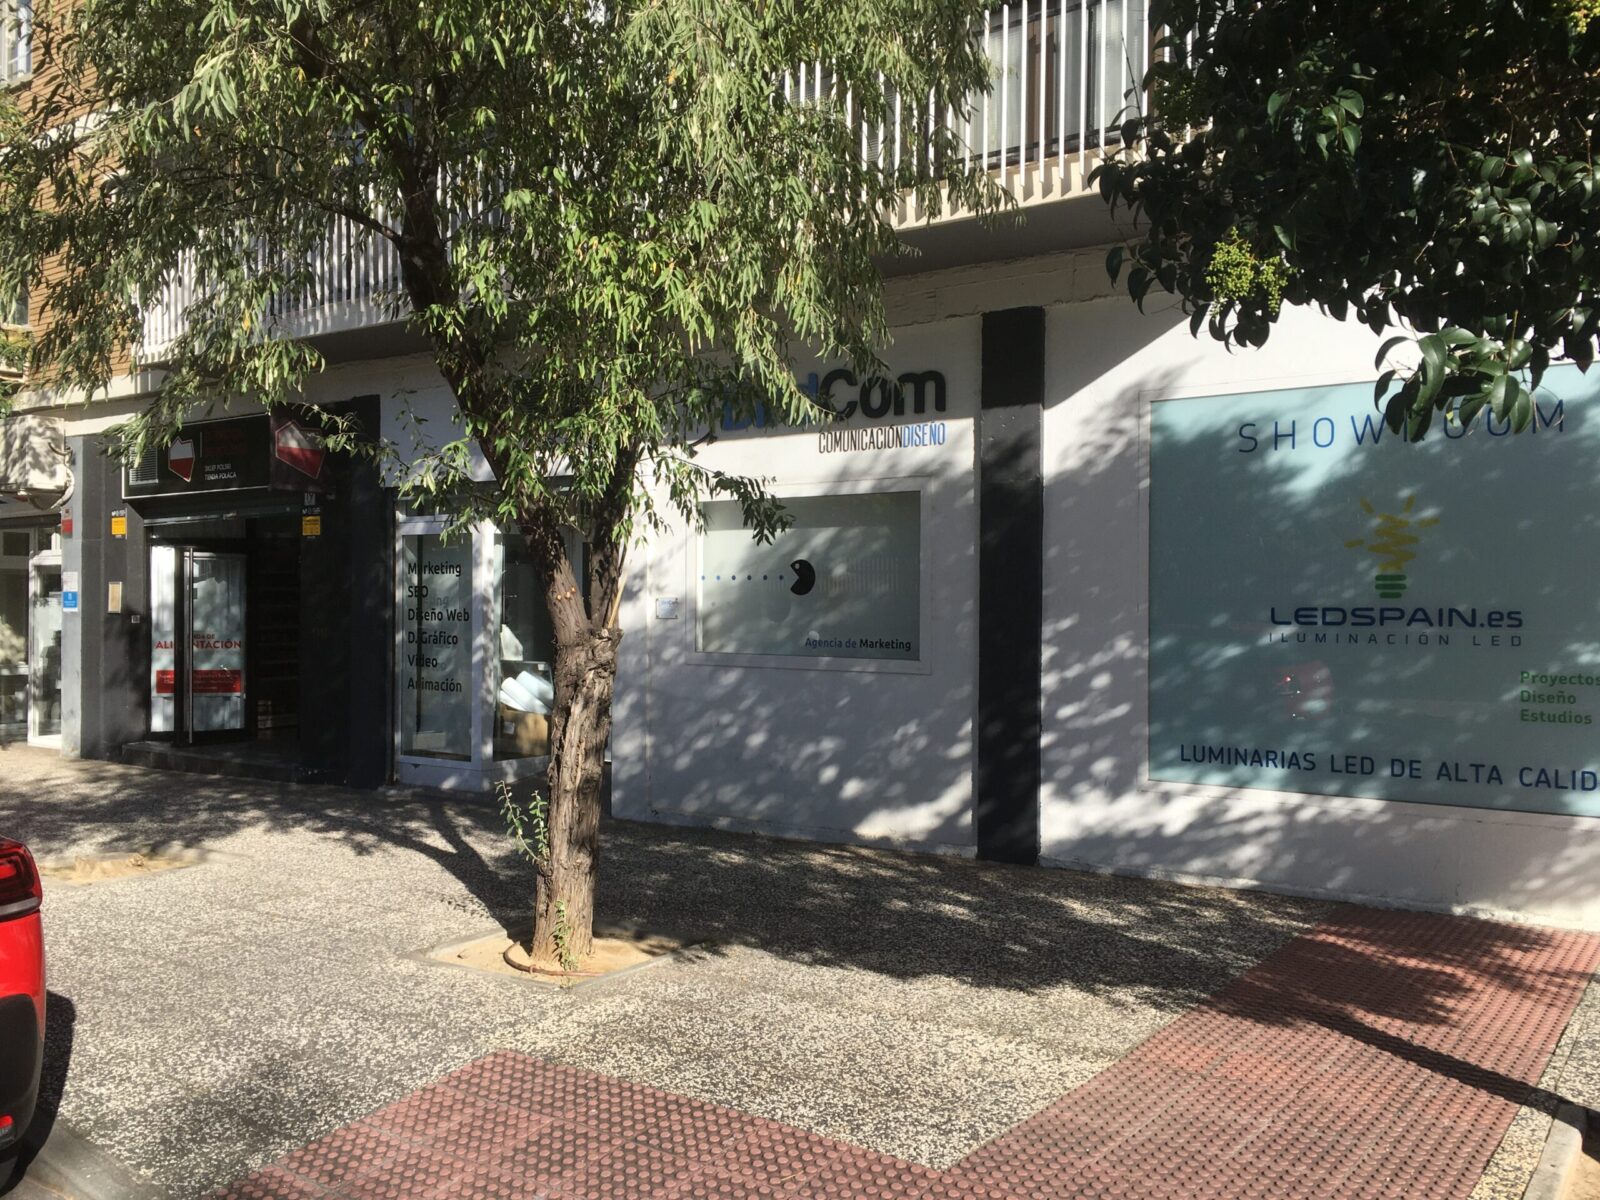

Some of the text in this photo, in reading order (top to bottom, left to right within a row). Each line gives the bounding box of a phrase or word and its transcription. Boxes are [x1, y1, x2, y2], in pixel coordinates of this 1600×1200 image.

[1238, 399, 1564, 453] SHOWOOM
[407, 561, 462, 577] Mrketing
[407, 585, 429, 598] SEO
[446, 608, 470, 622] Web
[1270, 607, 1523, 628] LEDSPAIN.es
[155, 638, 242, 649] ALINTACIÓN
[804, 637, 912, 652] Agencia de Marketing
[1269, 632, 1522, 647] ILUMINACIÓN LED
[1520, 690, 1577, 705] Diseño
[1520, 708, 1593, 725] Estudios
[1180, 744, 1317, 772] LUMINARIAS
[1330, 754, 1375, 776] LED
[1390, 758, 1422, 779] DE
[1436, 761, 1503, 785] ALTA
